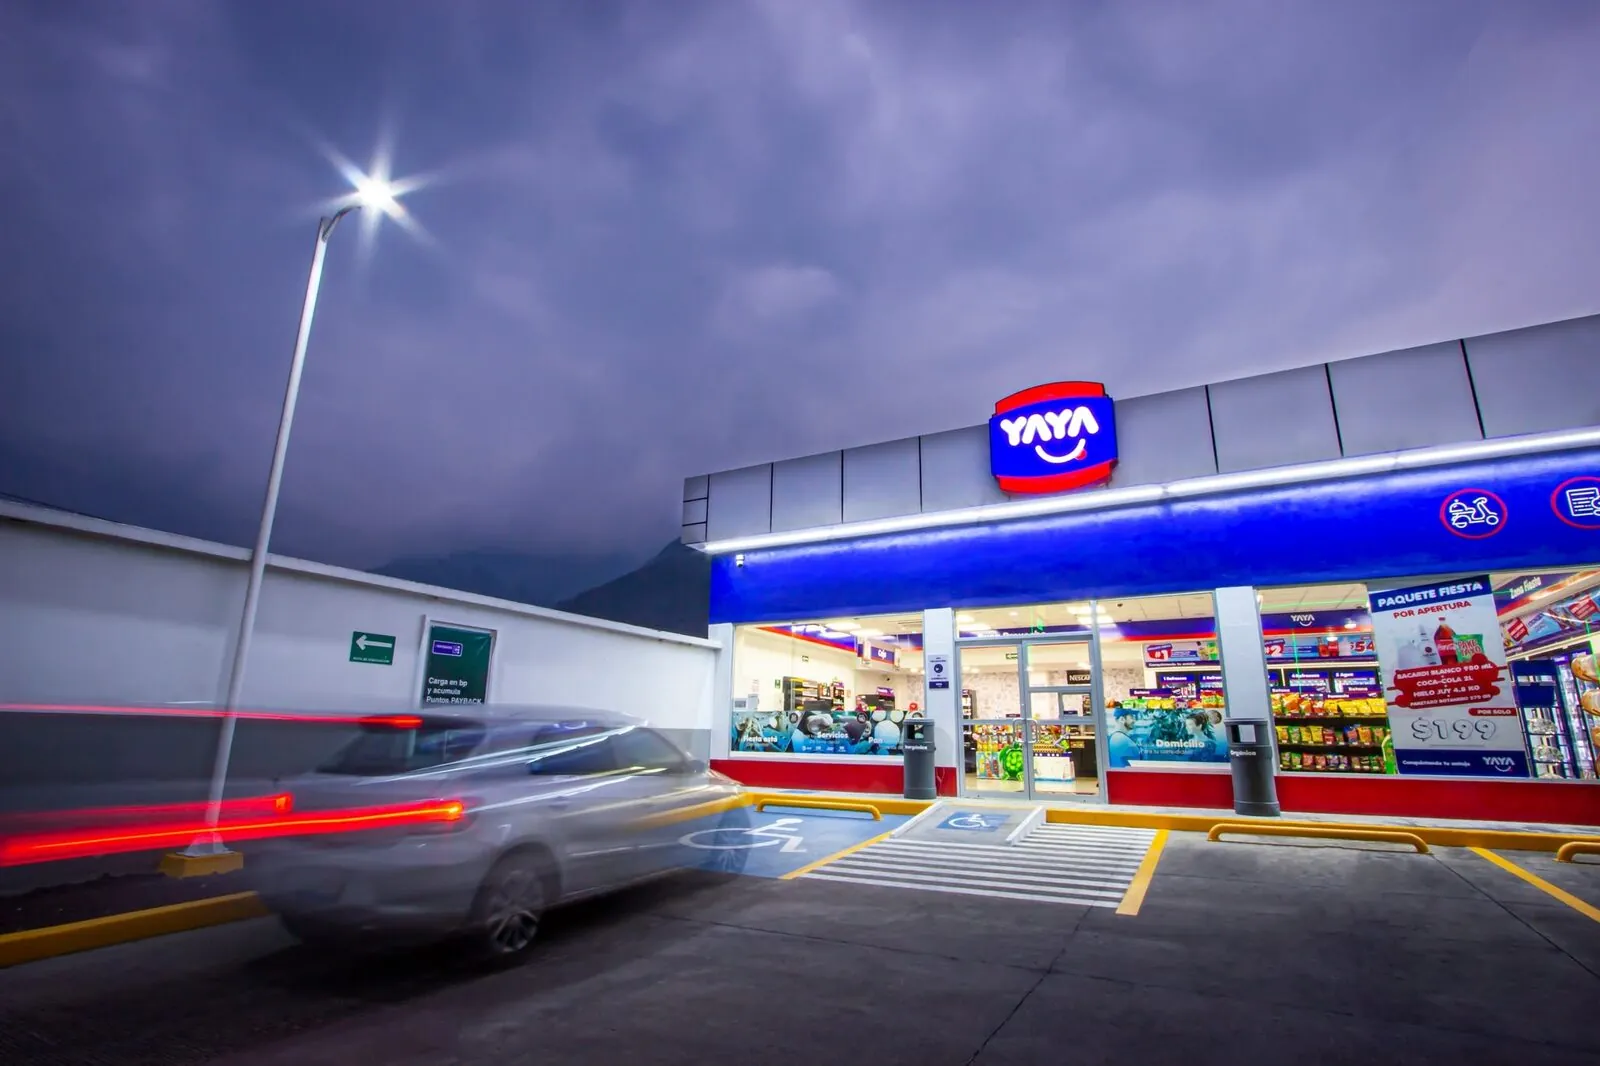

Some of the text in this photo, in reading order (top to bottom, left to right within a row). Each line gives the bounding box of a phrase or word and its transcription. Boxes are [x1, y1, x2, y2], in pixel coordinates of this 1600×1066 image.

[1000, 406, 1099, 446] YAYA
[1377, 582, 1484, 608] PAQUETE FIESTA
[1510, 585, 1524, 599] Zona
[1393, 600, 1472, 619] POR APERTURA
[1290, 614, 1315, 622] YAYA
[1397, 671, 1429, 680] BACARDI
[1430, 667, 1462, 676] BLANCO
[428, 677, 448, 686] Carga
[459, 679, 468, 687] bp
[1416, 677, 1462, 687] COCA-COLA
[433, 687, 461, 695] acumula
[1413, 690, 1435, 698] HIELO
[426, 696, 482, 705] Puntos PAYBACK
[1411, 717, 1496, 742] $199
[1155, 739, 1205, 748] Domicilio
[1482, 756, 1515, 766] YAYA
